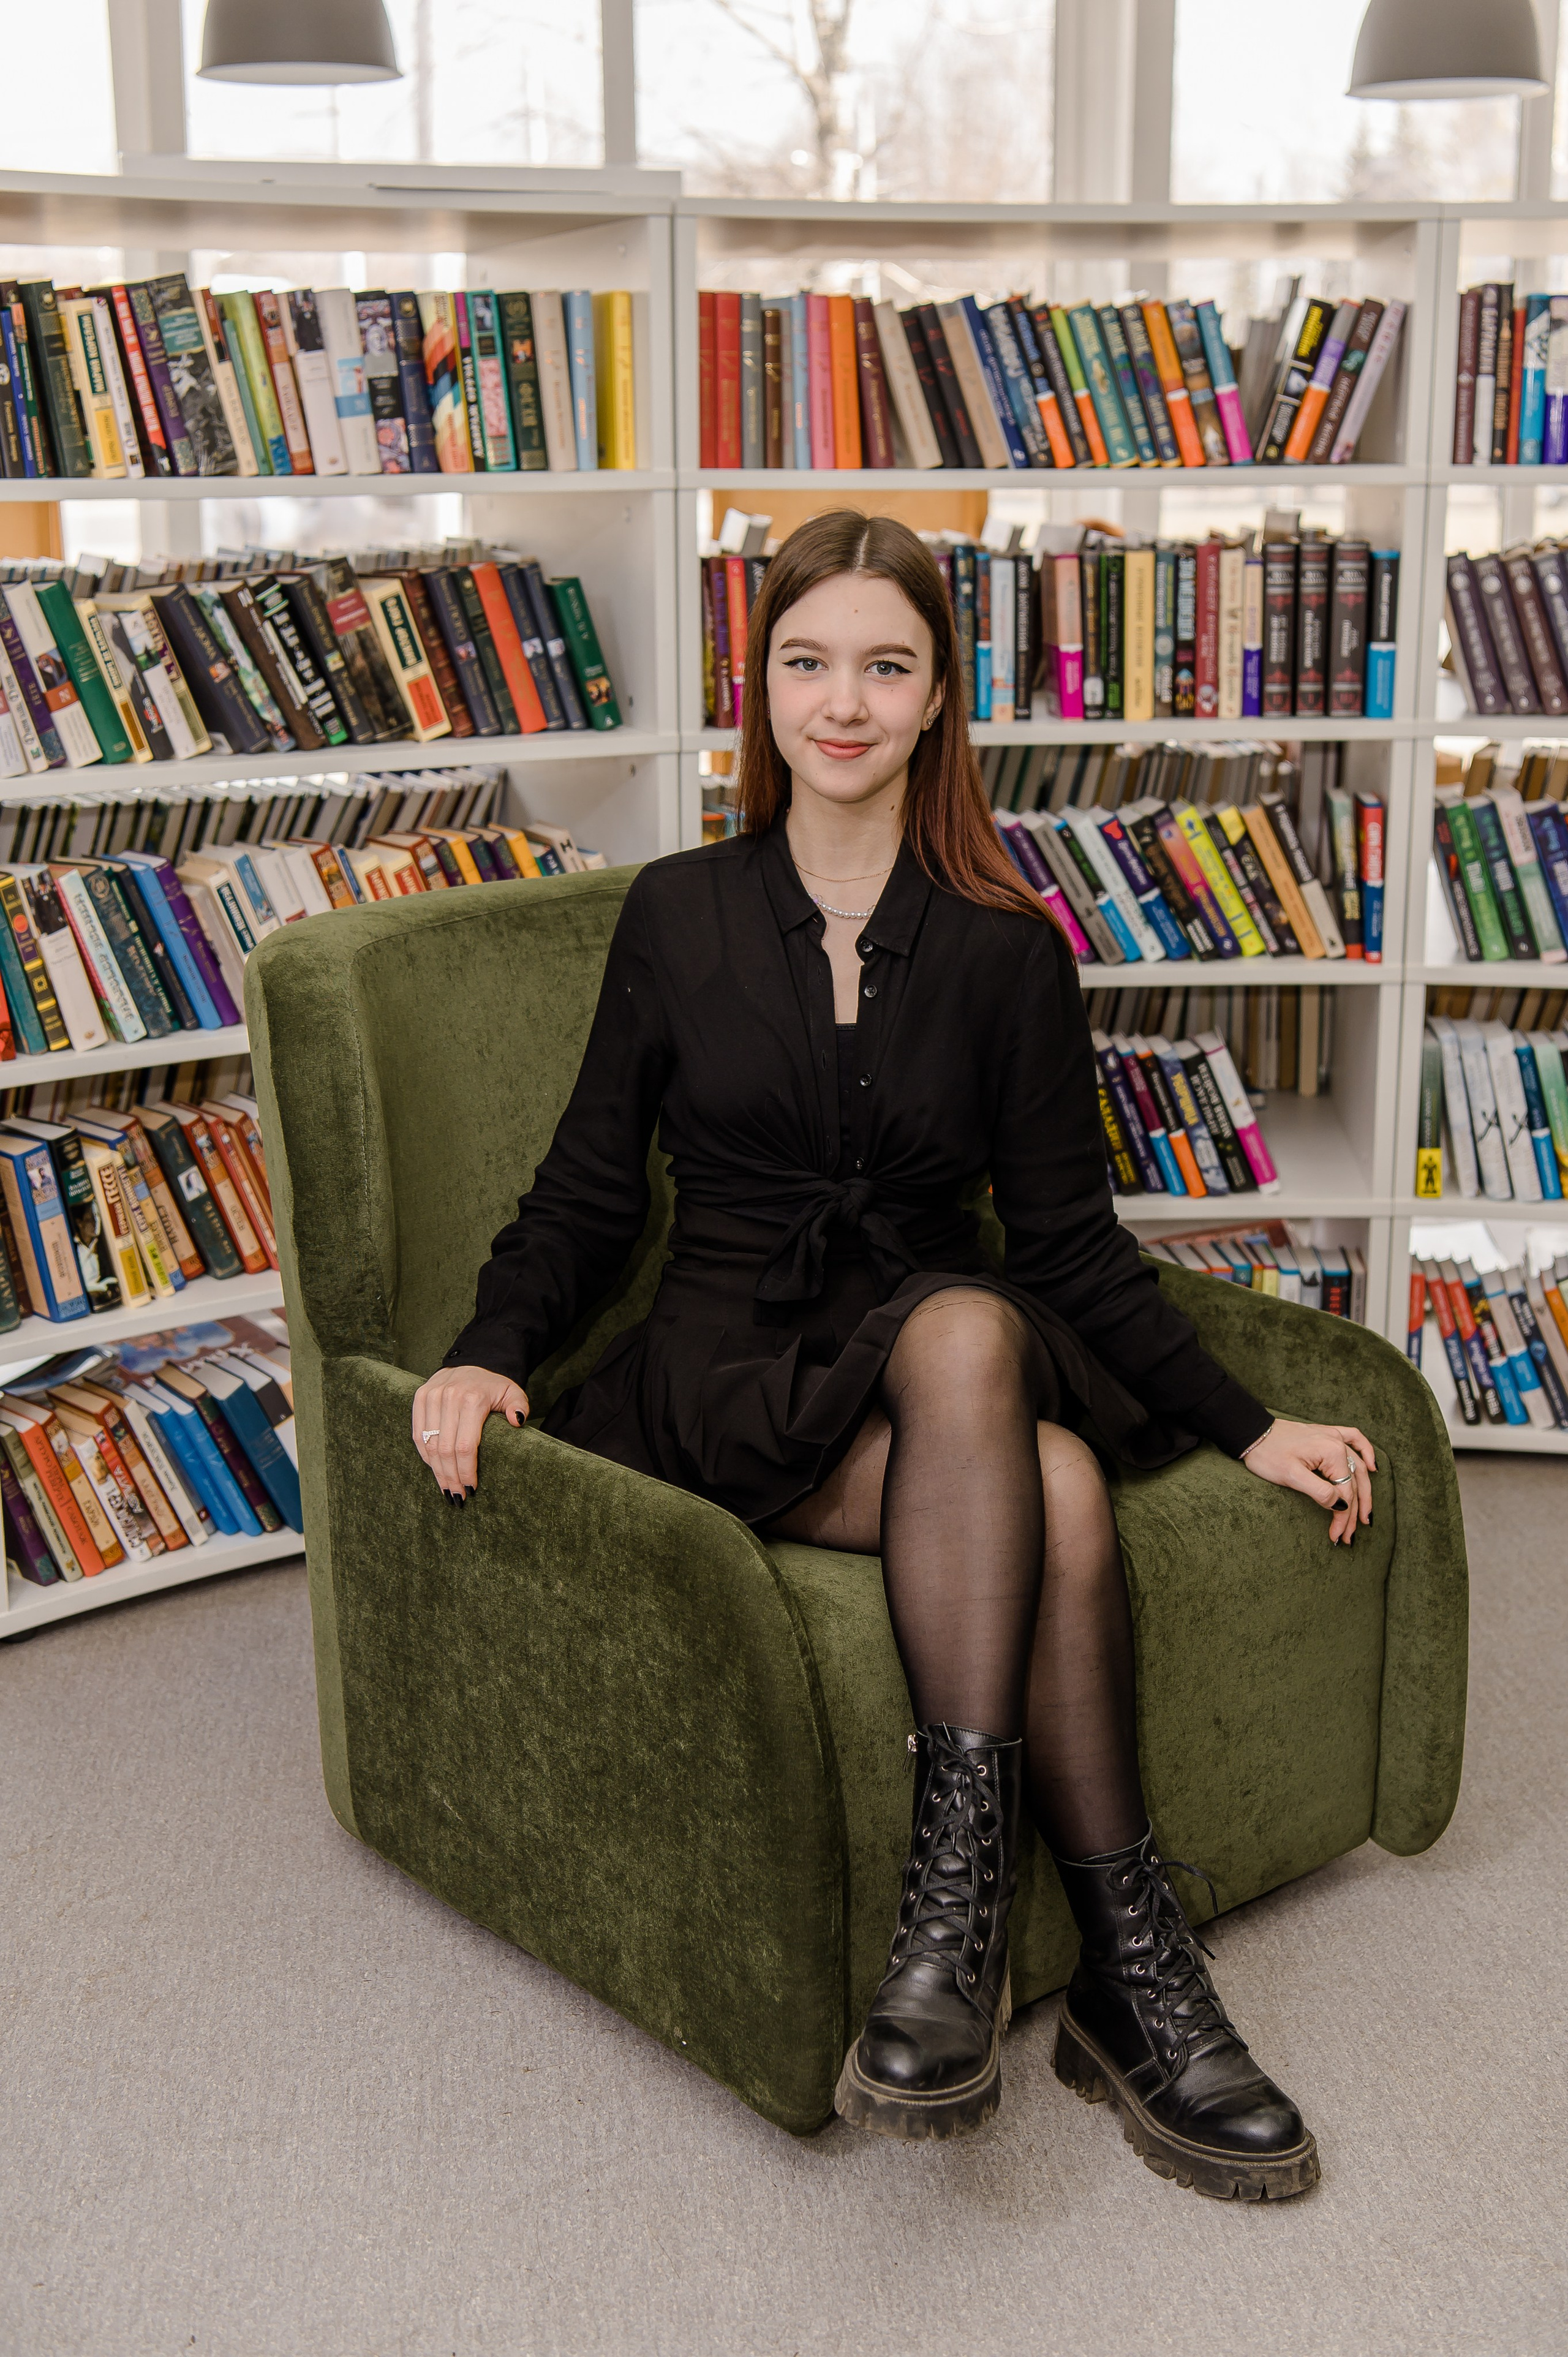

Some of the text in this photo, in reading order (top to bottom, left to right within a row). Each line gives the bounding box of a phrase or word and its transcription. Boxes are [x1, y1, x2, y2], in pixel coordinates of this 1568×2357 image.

[89, 358, 105, 392] МАРИЯ
[385, 597, 420, 666] ВИКТОР ГЮГО
[219, 886, 246, 931] ХЕМИНГУЭЙ
[1098, 1088, 1123, 1150] САЛАДИН
[1170, 1072, 1200, 1126] УБОРЩИЦА
[100, 1166, 129, 1235] ГЕРМАН ГЕССЕ
[117, 1167, 148, 1232] КУРТ ВОННЕГУТ
[34, 1435, 53, 1468] АРТУРО
[113, 1465, 145, 1514] АЭЛИТА
[67, 1506, 88, 1545] САБОТАЖ
